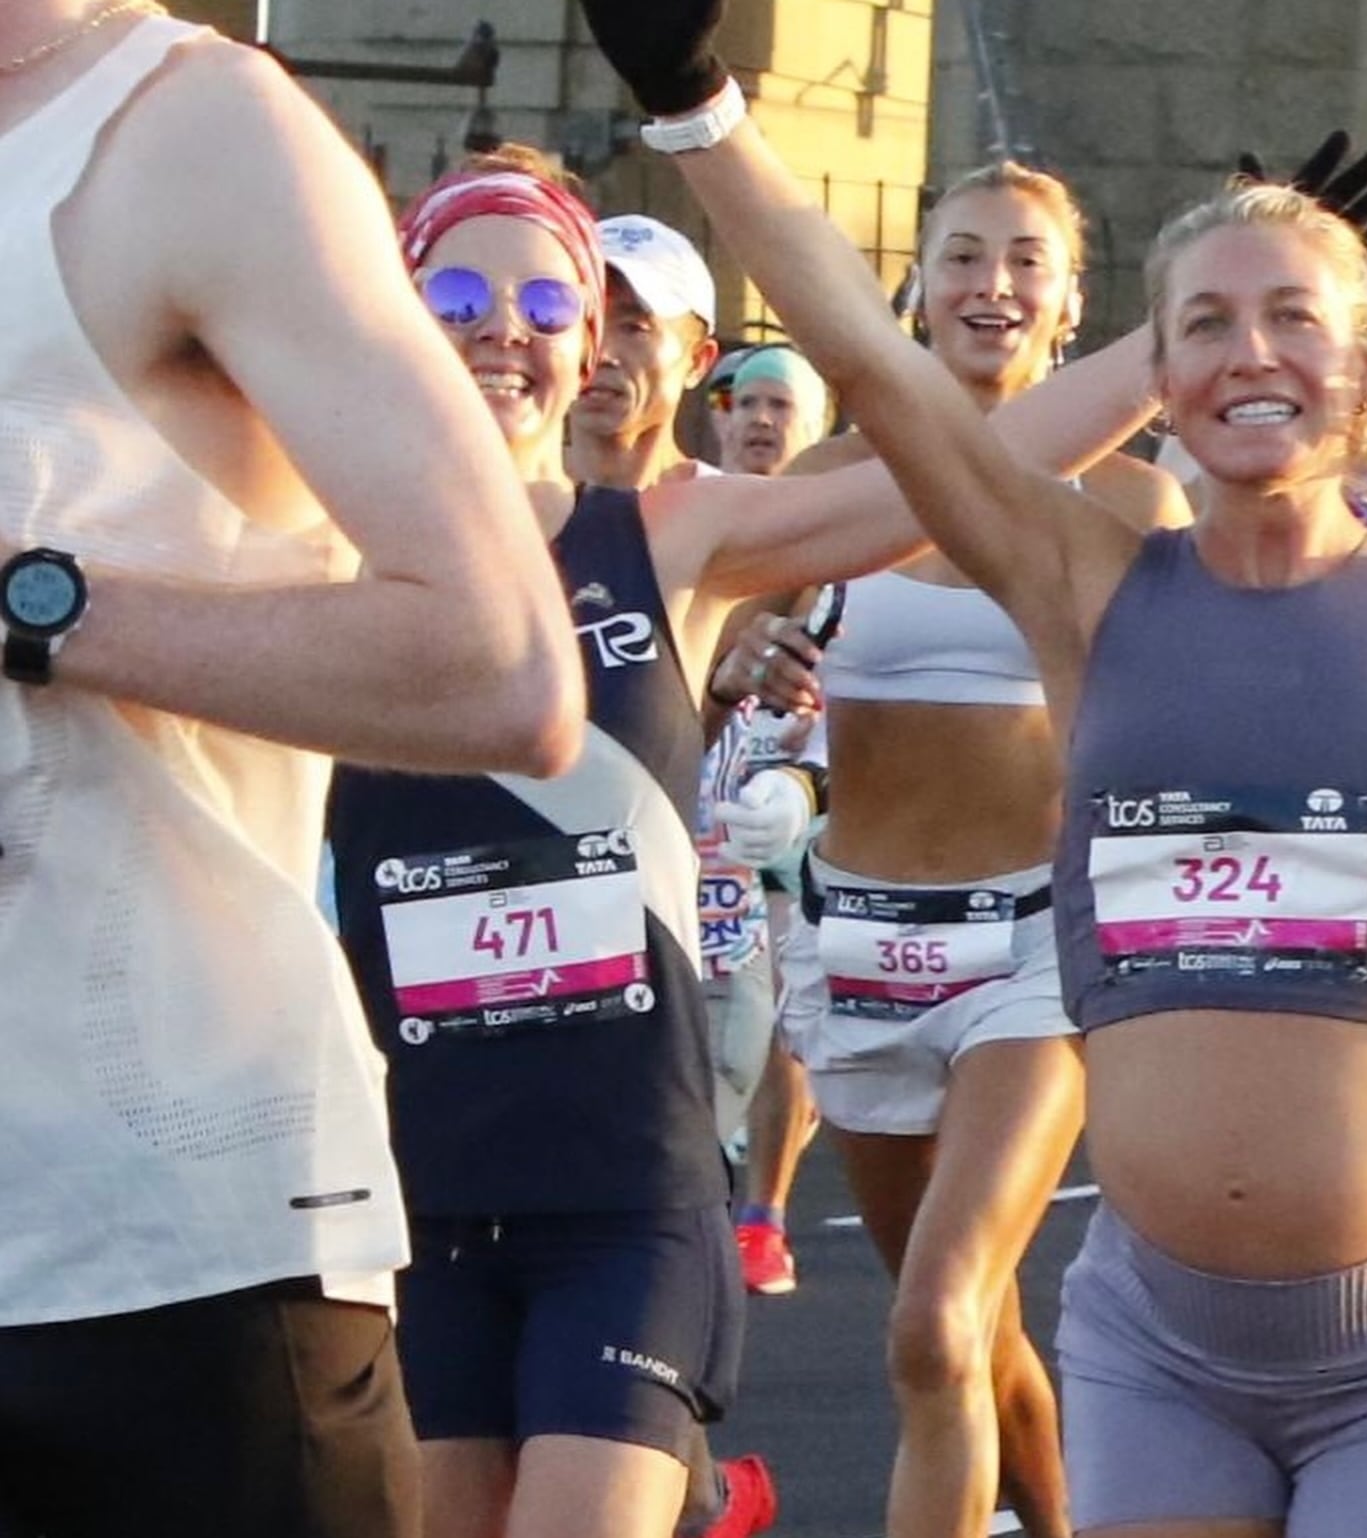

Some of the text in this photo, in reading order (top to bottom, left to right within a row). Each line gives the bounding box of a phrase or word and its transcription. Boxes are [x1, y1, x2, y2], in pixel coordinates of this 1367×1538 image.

[1108, 795, 1155, 827] tcs
[1300, 816, 1347, 830] TATA
[575, 860, 617, 875] TATA
[1172, 856, 1282, 903] 324
[472, 906, 559, 960] 471
[876, 940, 948, 973] 365
[620, 1350, 679, 1384] BANDIT
